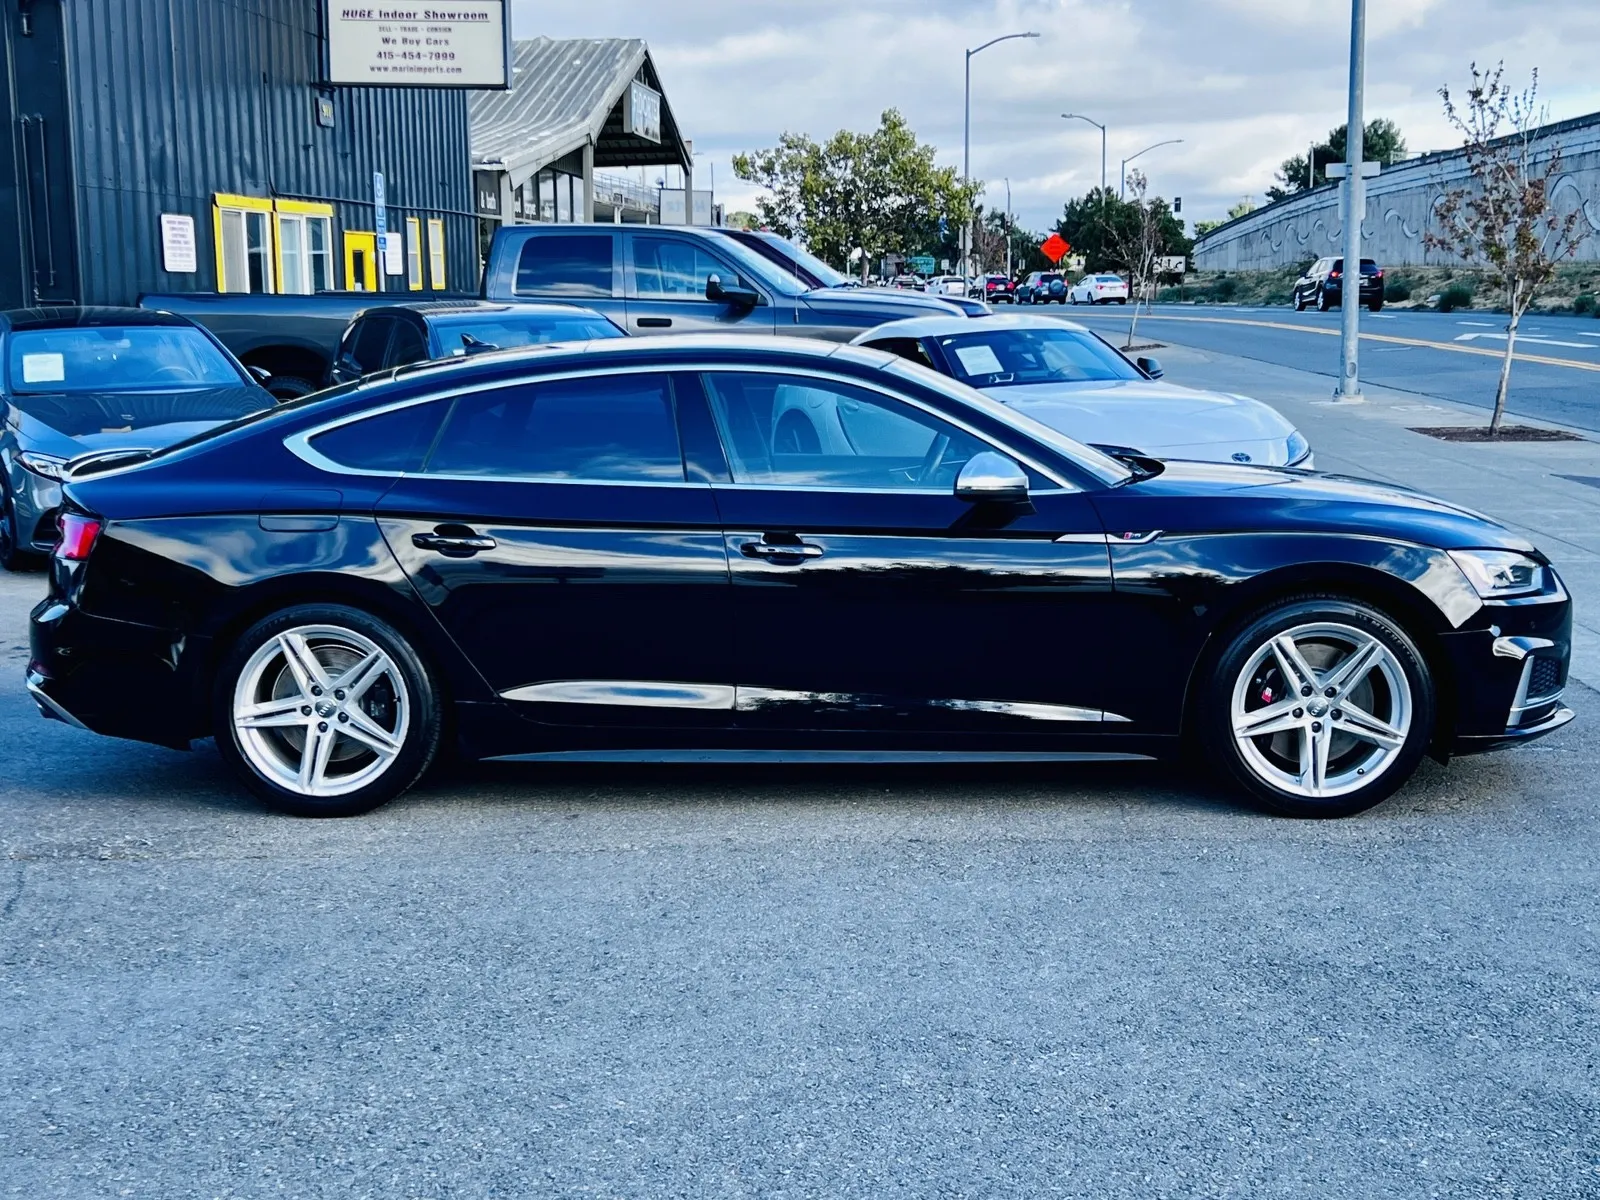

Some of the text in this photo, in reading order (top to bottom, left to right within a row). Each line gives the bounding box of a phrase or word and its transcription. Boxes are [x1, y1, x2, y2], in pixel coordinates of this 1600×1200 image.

[342, 9, 489, 20] HUGE Indoor Showroom
[382, 37, 450, 46] We Buy Cars
[376, 51, 455, 61] 415-454-7999
[369, 64, 462, 74] www.marinimports.com
